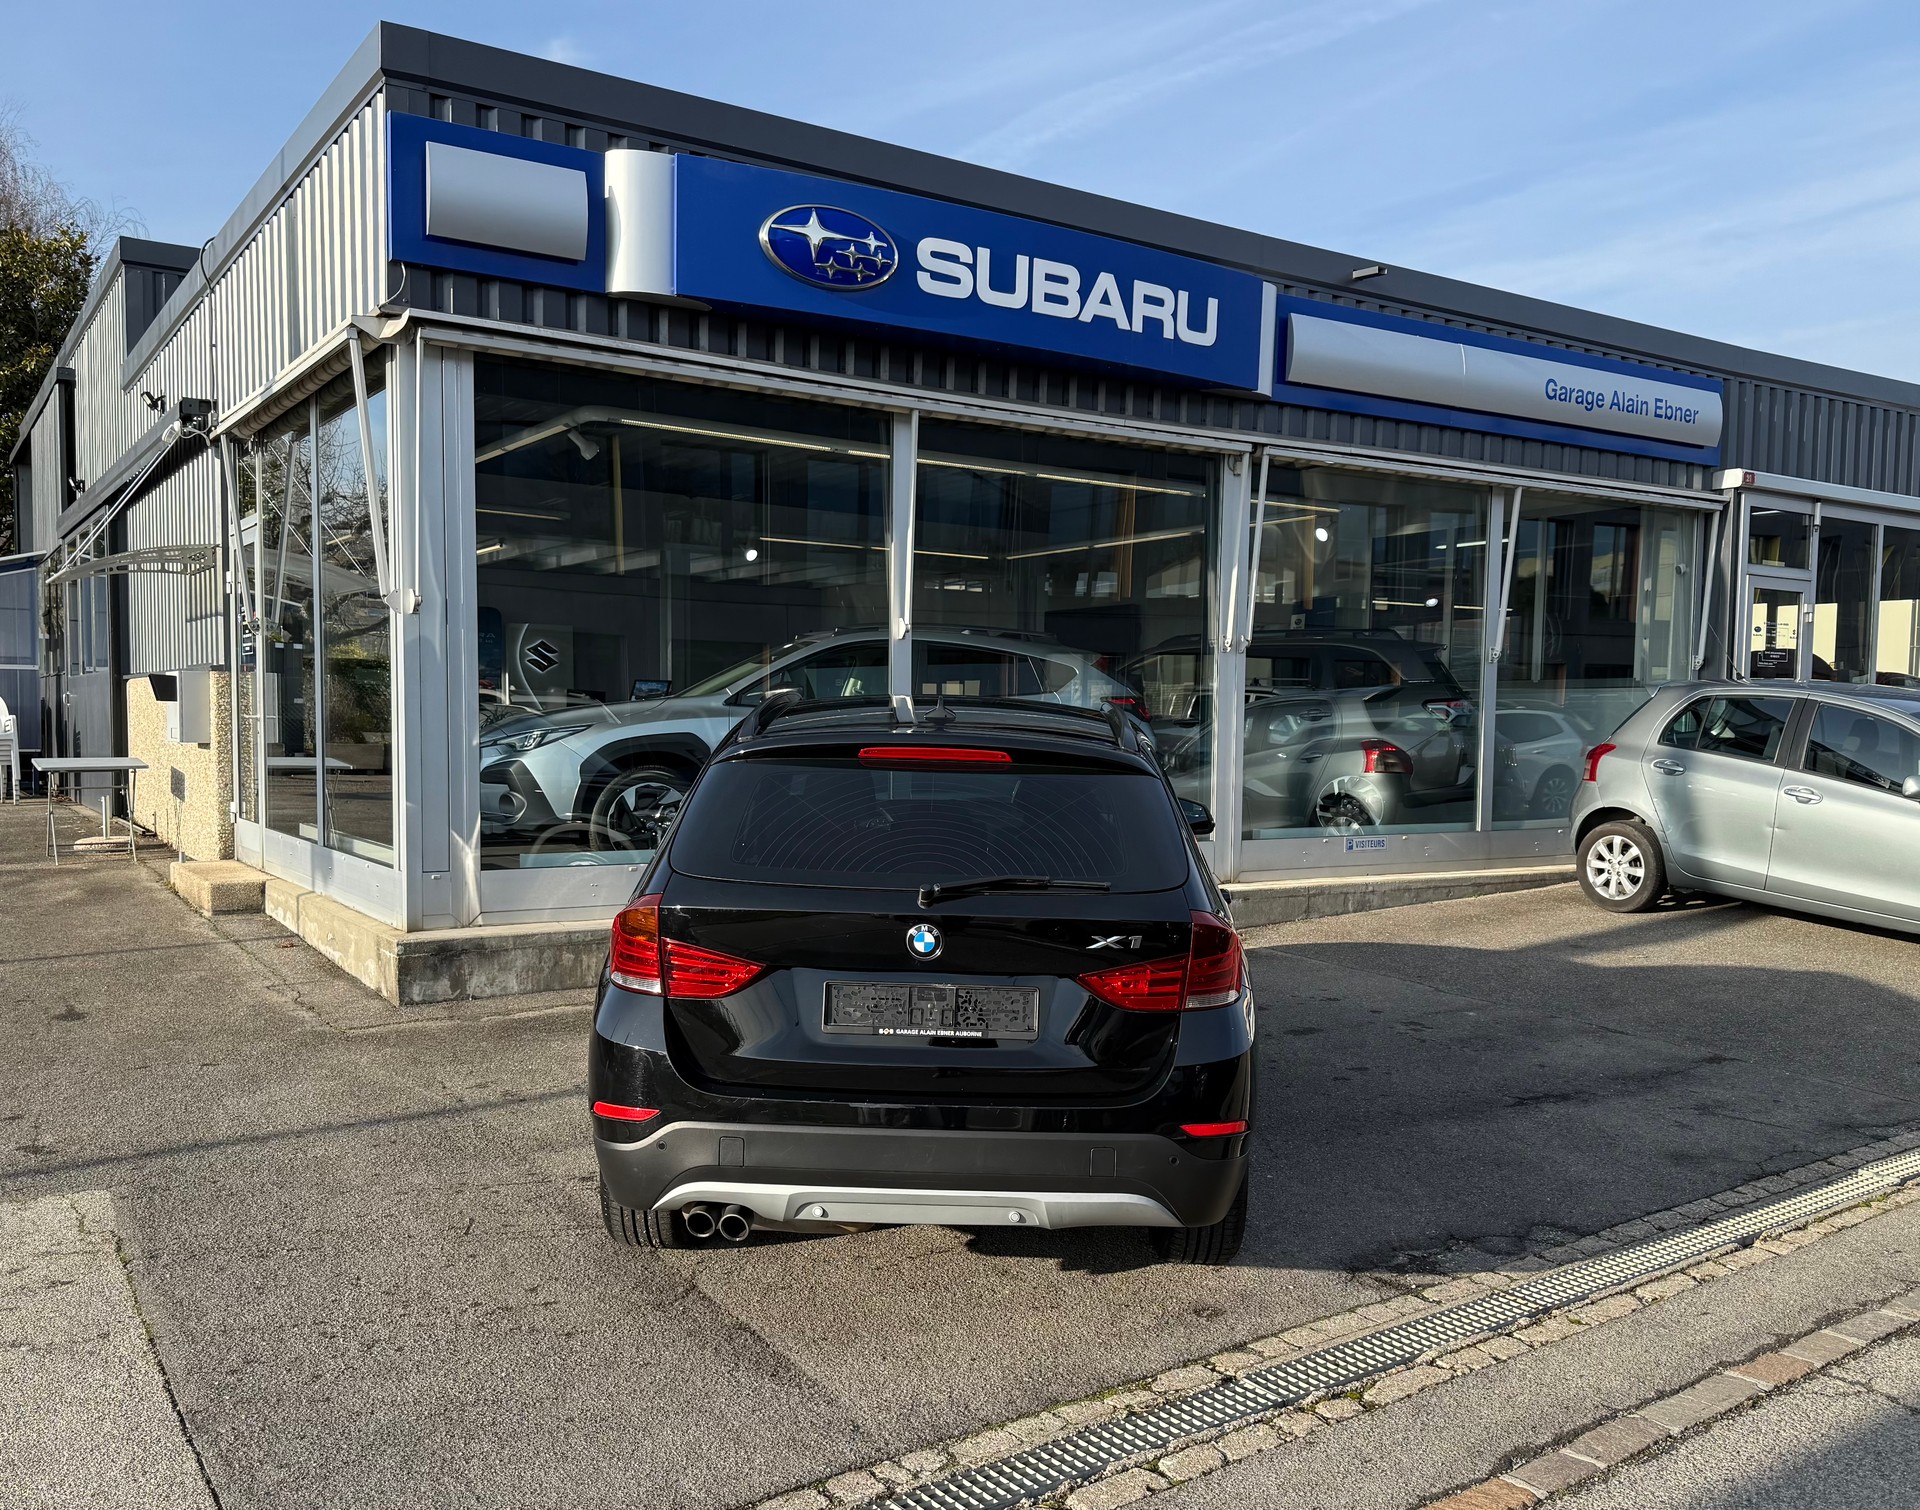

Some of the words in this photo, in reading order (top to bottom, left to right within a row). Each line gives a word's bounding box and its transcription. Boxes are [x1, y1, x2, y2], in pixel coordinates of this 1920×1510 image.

[916, 236, 1219, 348] SUBARU
[1545, 378, 1605, 412] Garage
[1609, 390, 1649, 416] Alain
[1654, 397, 1699, 424] Ebner
[1355, 839, 1385, 848] VISITEURS
[910, 925, 939, 936] BMW
[1086, 935, 1143, 949] X1
